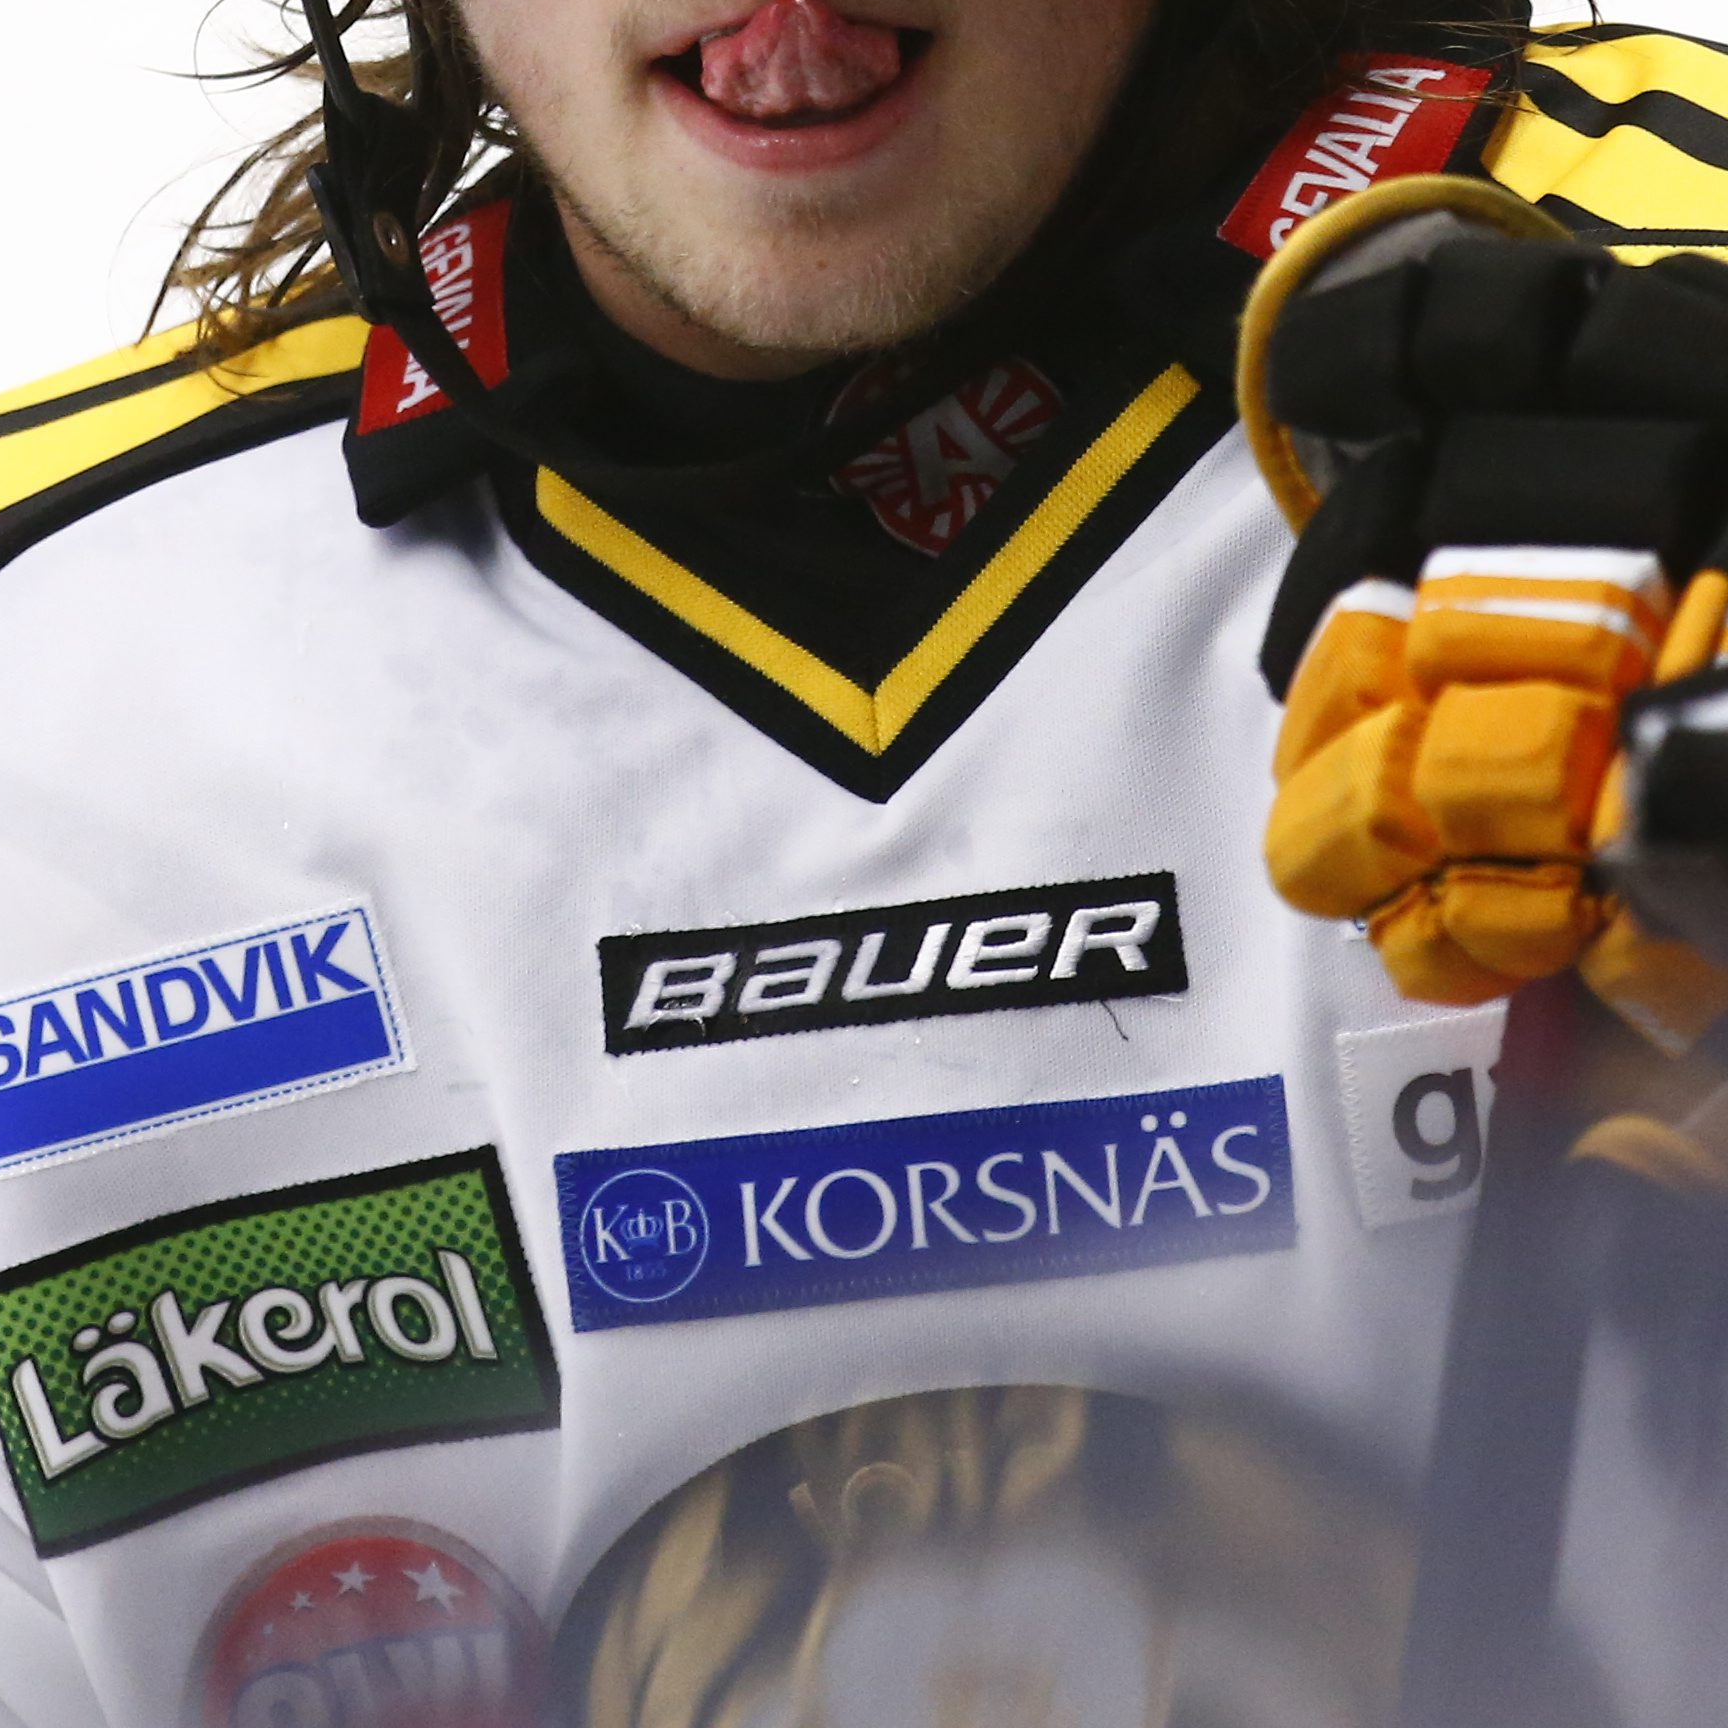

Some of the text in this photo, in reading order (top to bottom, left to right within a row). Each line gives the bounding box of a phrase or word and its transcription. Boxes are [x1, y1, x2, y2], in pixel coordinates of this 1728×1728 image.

[623, 899, 1162, 1032] BAUER
[739, 1110, 1272, 1268] KORSNÄS
[12, 1247, 499, 1480] Läkerol
